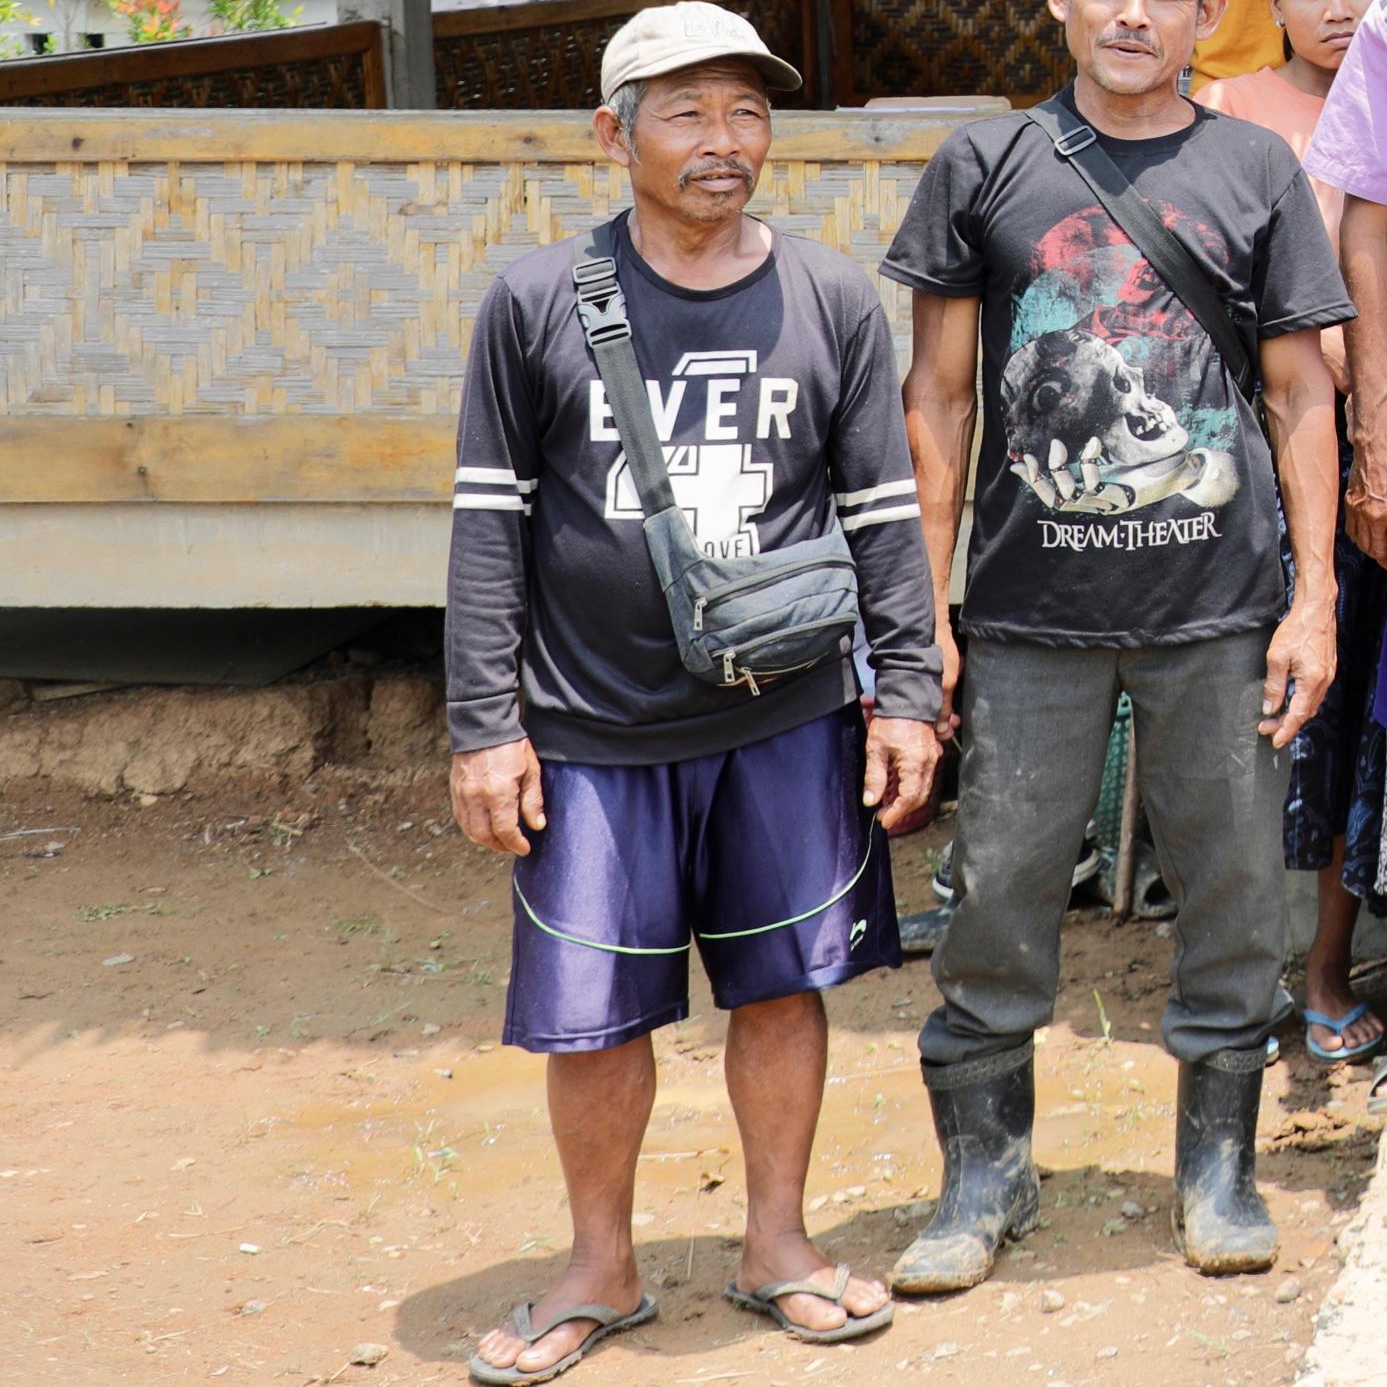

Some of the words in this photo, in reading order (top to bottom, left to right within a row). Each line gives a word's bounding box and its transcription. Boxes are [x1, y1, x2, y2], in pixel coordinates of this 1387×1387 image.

[589, 377, 799, 442] EVER
[704, 539, 744, 559] OVE
[1037, 519, 1123, 551] DREAM
[1120, 512, 1222, 551] THEATER
